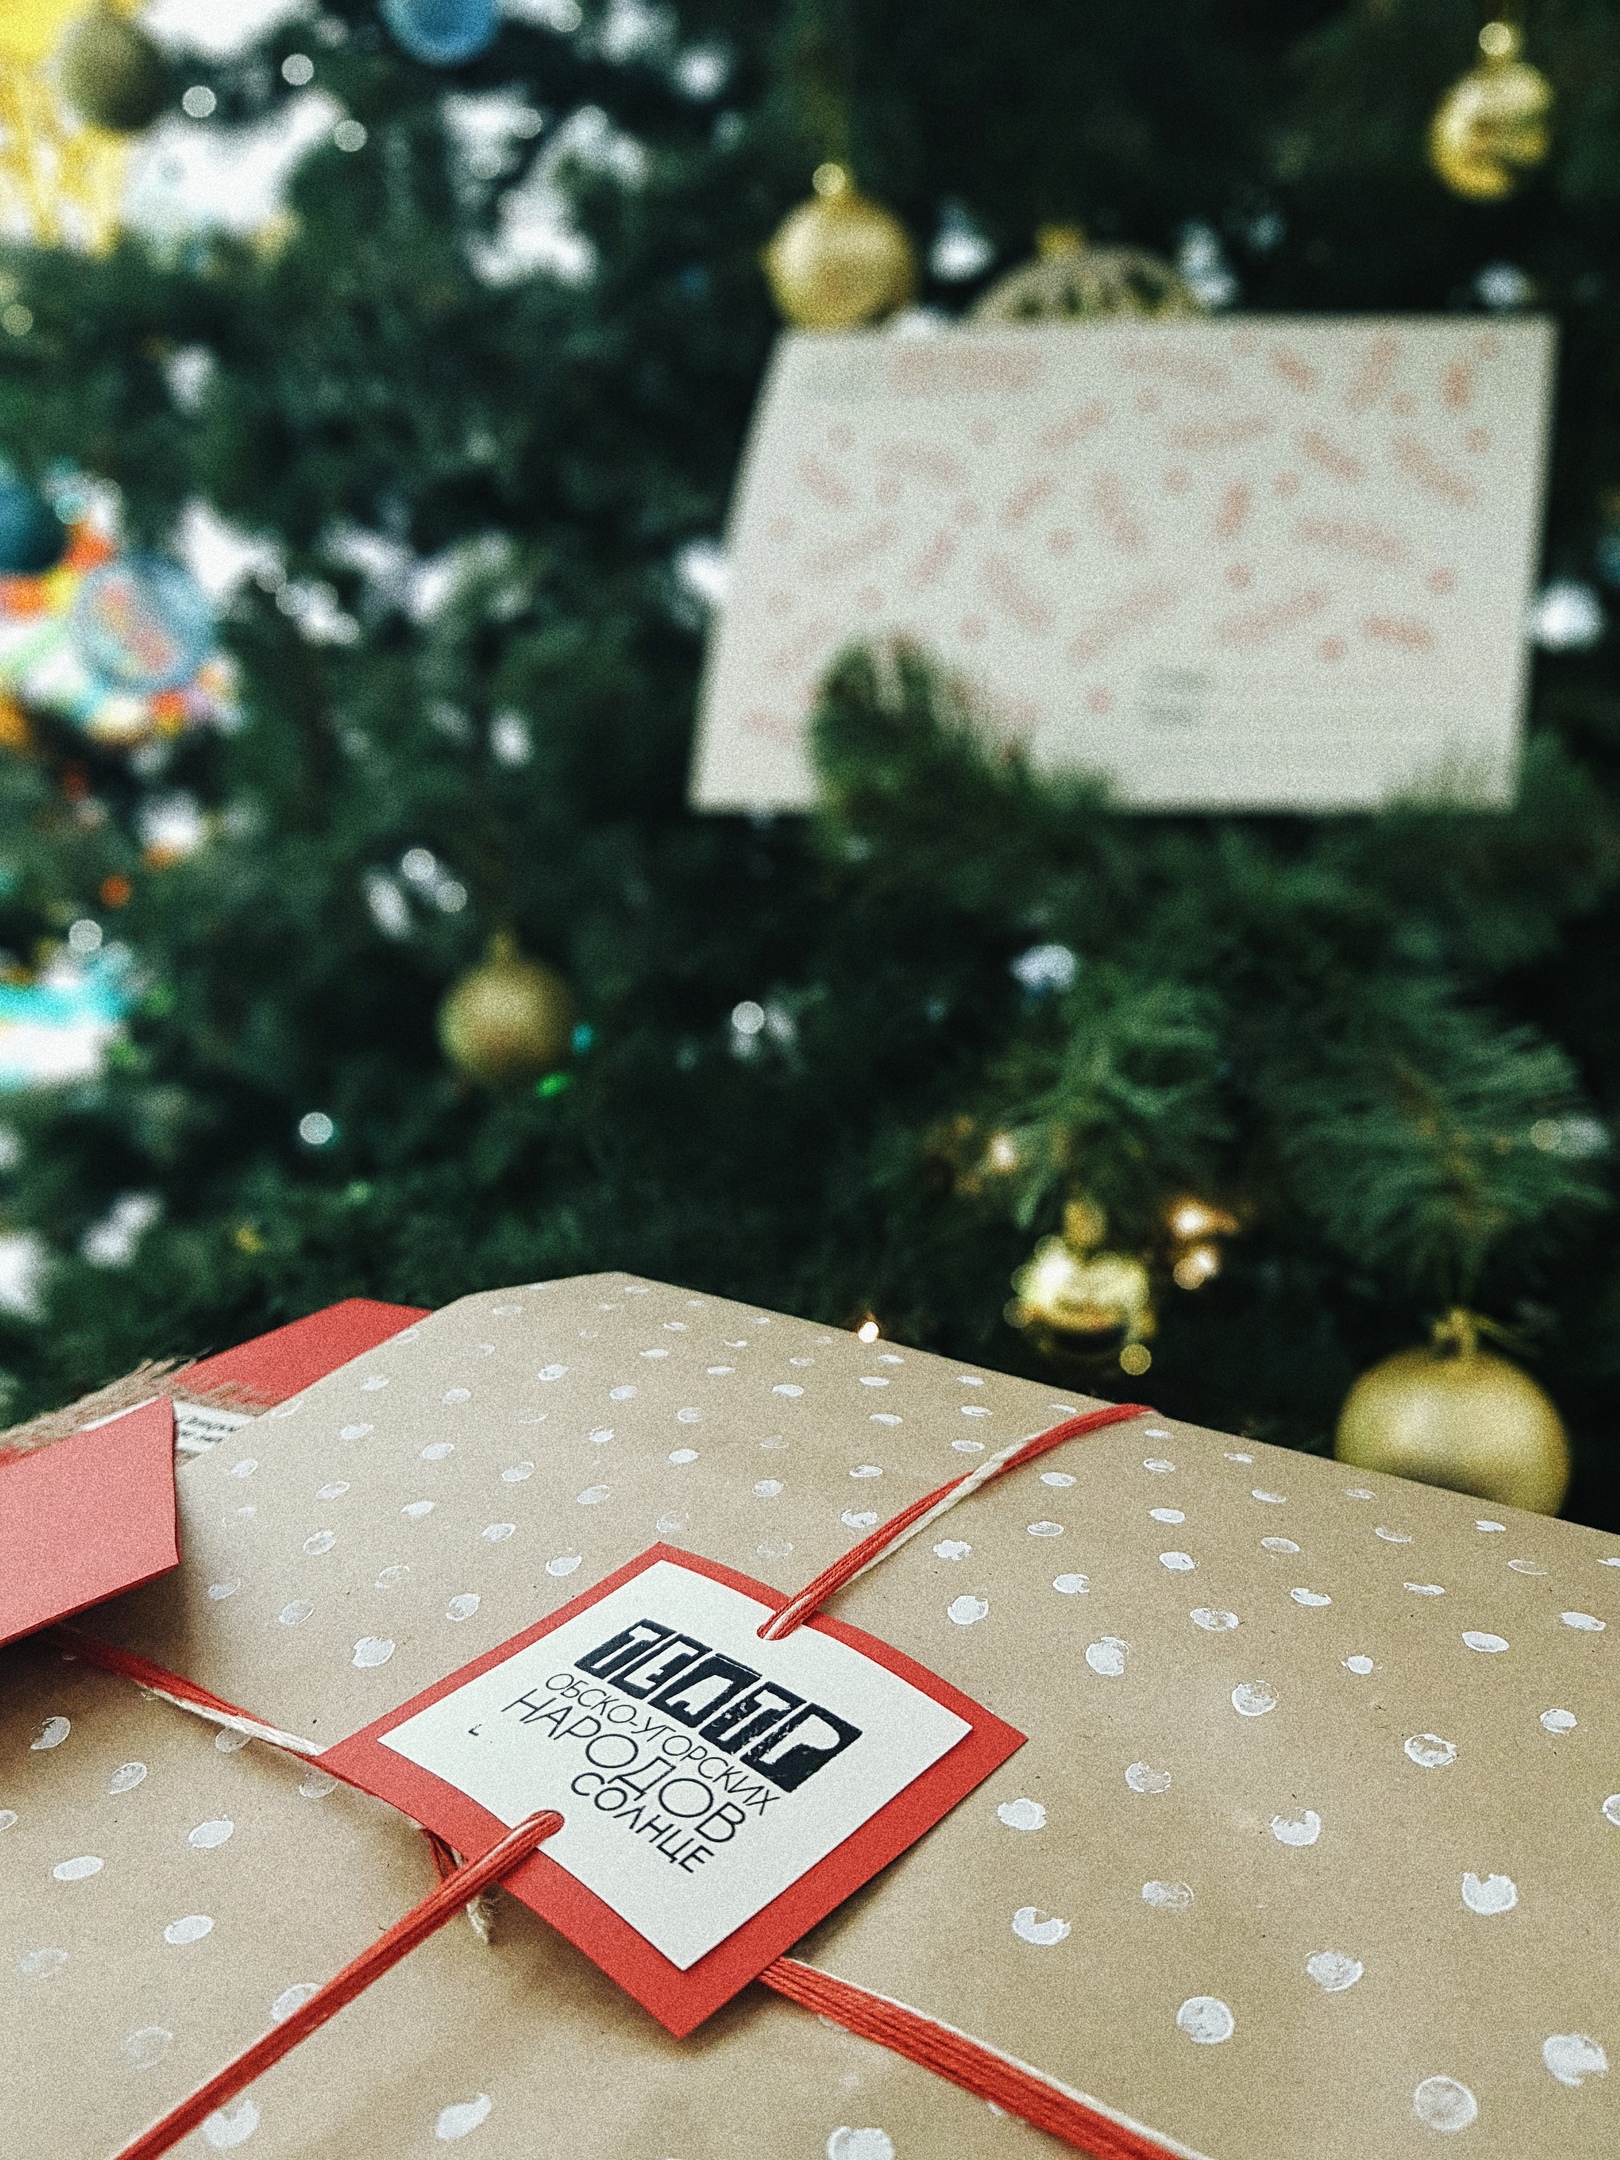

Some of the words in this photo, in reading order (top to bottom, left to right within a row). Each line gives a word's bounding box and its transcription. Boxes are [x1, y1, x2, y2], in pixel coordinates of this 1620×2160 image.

[501, 1689, 746, 1842] НАРОДОВ
[545, 1673, 780, 1816] ОБСКО-УГОРСКИХ
[574, 1619, 862, 1793] ТЕАТР
[571, 1772, 714, 1873] СОЛНЦЕ
